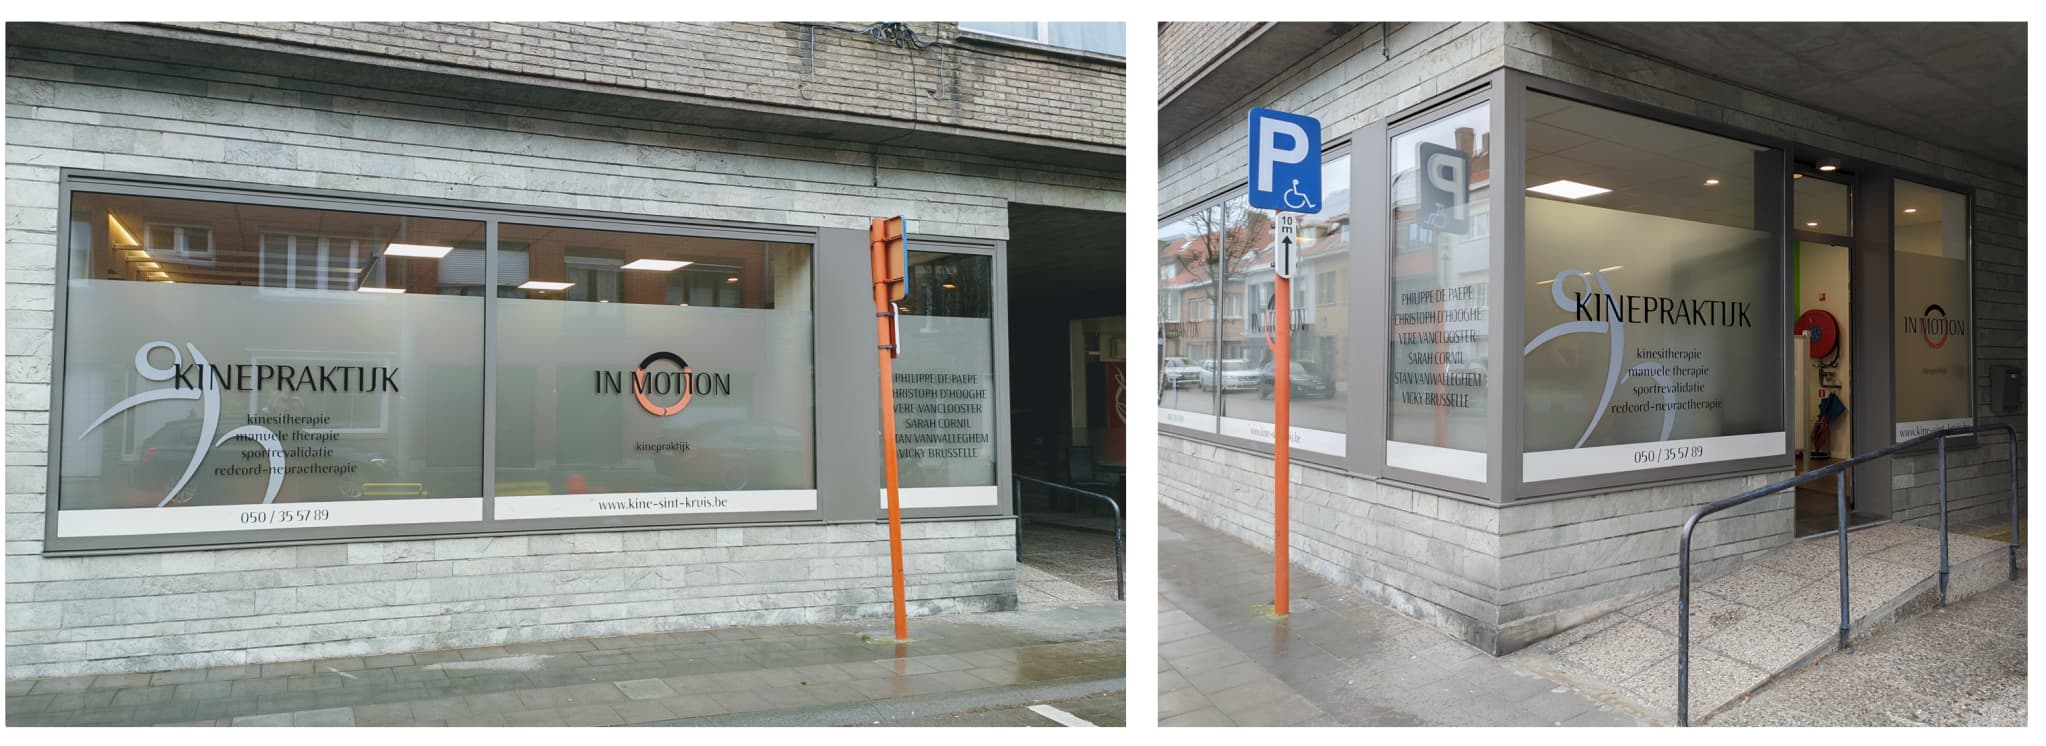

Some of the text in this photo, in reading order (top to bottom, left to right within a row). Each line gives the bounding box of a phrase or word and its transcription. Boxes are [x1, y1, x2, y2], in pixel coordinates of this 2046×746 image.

[1257, 116, 1310, 193] P
[1281, 216, 1293, 226] 10
[1281, 225, 1293, 234] m
[1401, 286, 1473, 305] PHILIPPE DE PAEPE
[1575, 291, 1752, 328] KINEPRAKTIJK
[1394, 311, 1436, 326] CHRISTOPH
[1904, 316, 1965, 336] IN MOTION
[1398, 329, 1477, 345] VERE VANCLOOSTER
[1408, 351, 1465, 365] SARAH CORNIL
[1636, 347, 1702, 361] kinesitherapie
[174, 363, 400, 393] KINEPRAKTIJK
[894, 373, 978, 385] PHILIPPE DE PAEPE
[1394, 371, 1482, 387] STAN VANWALLEGHEM
[1628, 364, 1709, 379] manuele therapie
[594, 370, 731, 395] IN MOTION
[1632, 382, 1705, 397] sportrevalidatie
[892, 388, 988, 400] HRISTOPH D'HOOGHE
[1401, 391, 1470, 408] VICKY BRUSSELLE
[893, 403, 983, 414] VERE VANCLOOSTER
[1611, 398, 1723, 414] redcord-neuractherapie
[247, 413, 331, 427] kinesitherapie
[904, 418, 972, 429] SARAH CORNIL
[235, 429, 341, 443] manuele therapie
[895, 433, 989, 443] TAN VANWALLEGHEM
[241, 446, 334, 460] sportrevalidatie
[635, 441, 691, 454] kinepraktijk
[897, 448, 978, 459] VICKY BRUSSELLE
[1634, 449, 1655, 463] 050
[1664, 447, 1676, 461] 35
[1677, 446, 1689, 459] 57
[1691, 445, 1703, 458] 89
[214, 463, 358, 477] redcord-neuractherapie
[598, 496, 728, 511] www.kine-sint-kruis.be
[240, 508, 330, 525] 050 / 35 57 89
